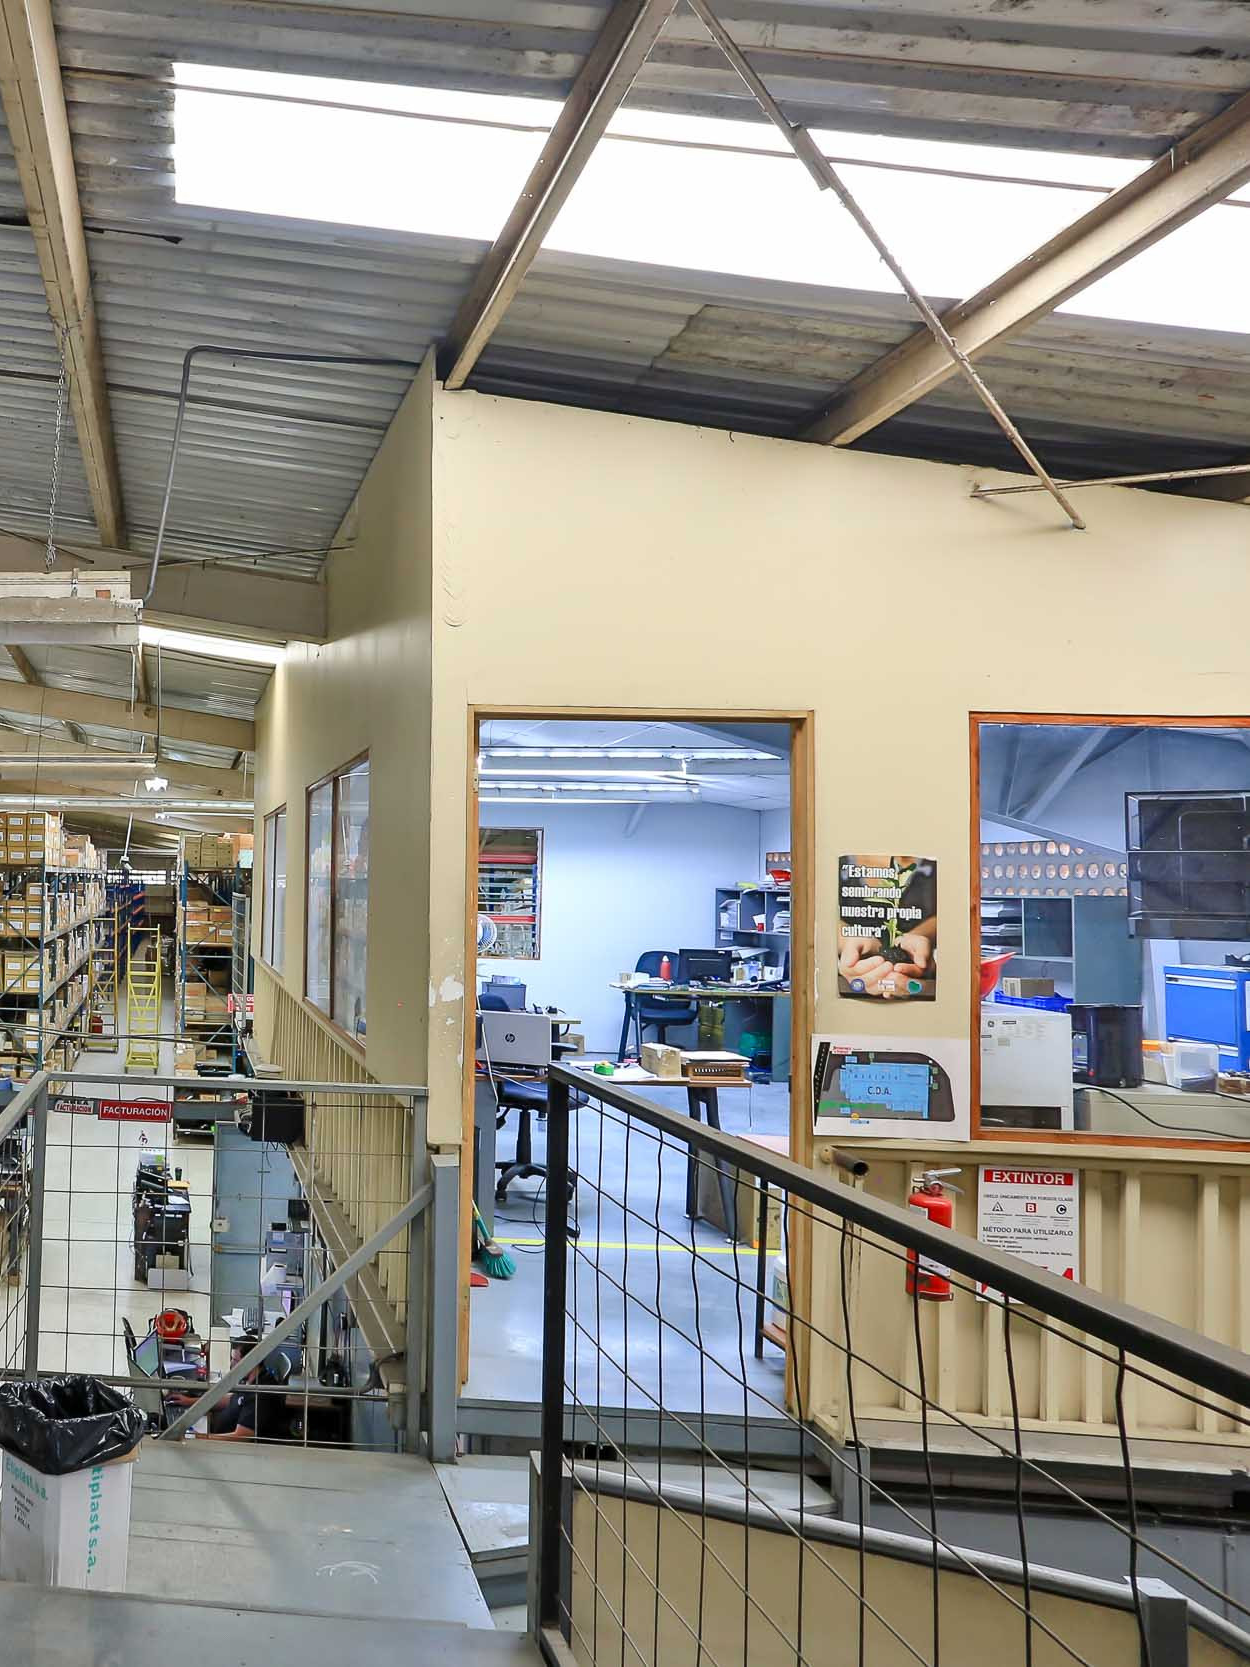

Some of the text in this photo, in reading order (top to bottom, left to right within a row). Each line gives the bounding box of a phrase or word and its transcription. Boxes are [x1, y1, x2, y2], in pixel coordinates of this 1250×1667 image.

[841, 885, 902, 899] sembrando
[841, 905, 922, 920] nuestra propia
[867, 1086, 892, 1095] C.D.A.
[103, 1106, 168, 1116] FACTURACIÓN
[992, 1171, 1065, 1185] EXTINTOR
[1033, 1229, 1074, 1237] UTILIZARLO
